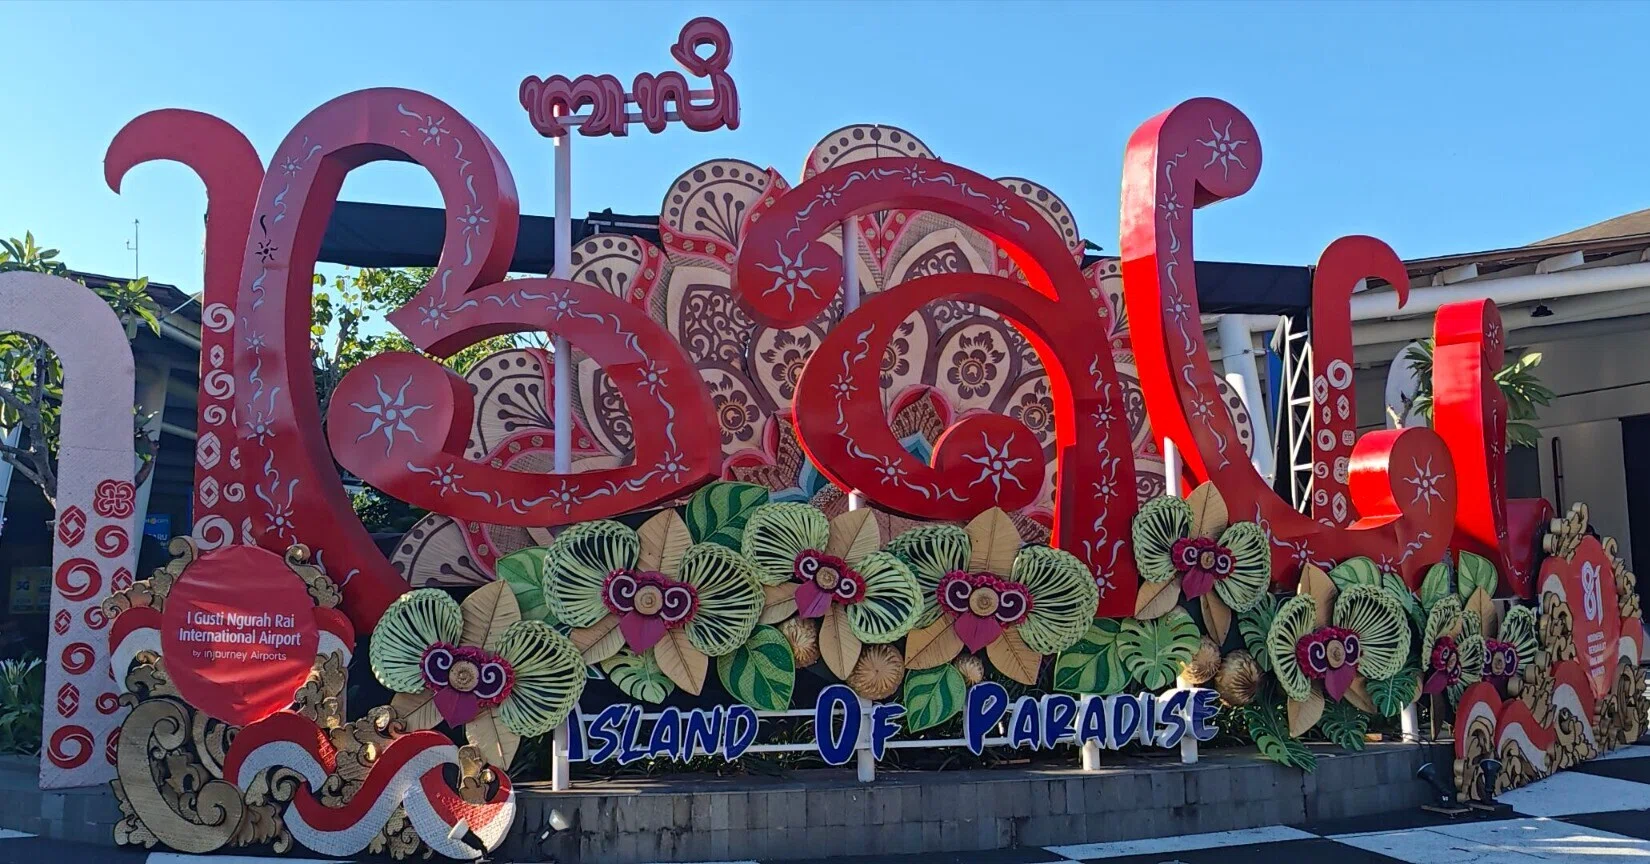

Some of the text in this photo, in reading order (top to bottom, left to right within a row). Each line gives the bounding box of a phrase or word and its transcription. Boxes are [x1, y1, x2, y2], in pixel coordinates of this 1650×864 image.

[1582, 561, 1603, 627] 81
[187, 611, 295, 630] I Gusti Ngurah Rai
[179, 628, 301, 648] International Airport
[192, 649, 201, 658] by
[250, 651, 287, 661] Airports
